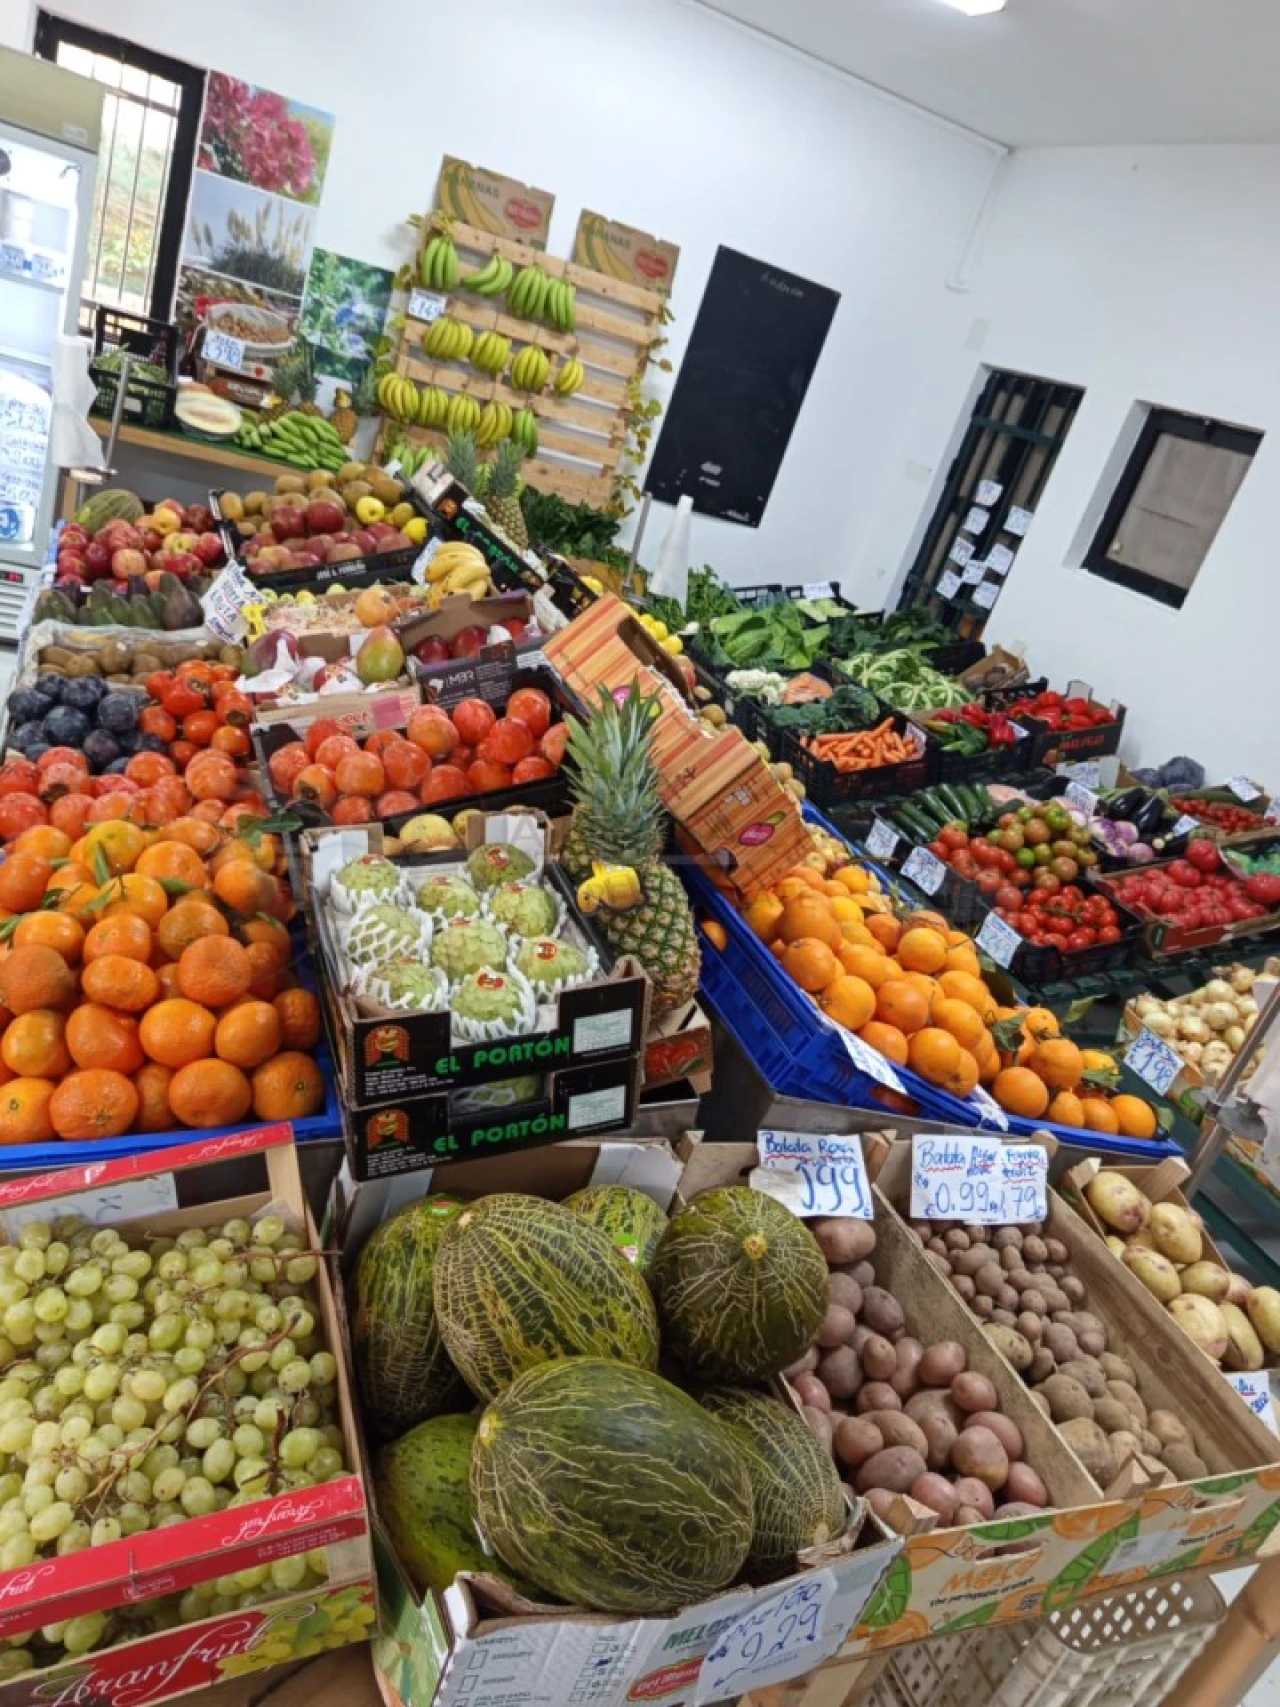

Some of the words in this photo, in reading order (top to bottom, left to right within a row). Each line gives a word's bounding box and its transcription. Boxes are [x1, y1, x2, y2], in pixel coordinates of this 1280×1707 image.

[435, 1056, 460, 1075] EL
[433, 1135, 459, 1154] EL
[659, 1667, 702, 1686] Mont
